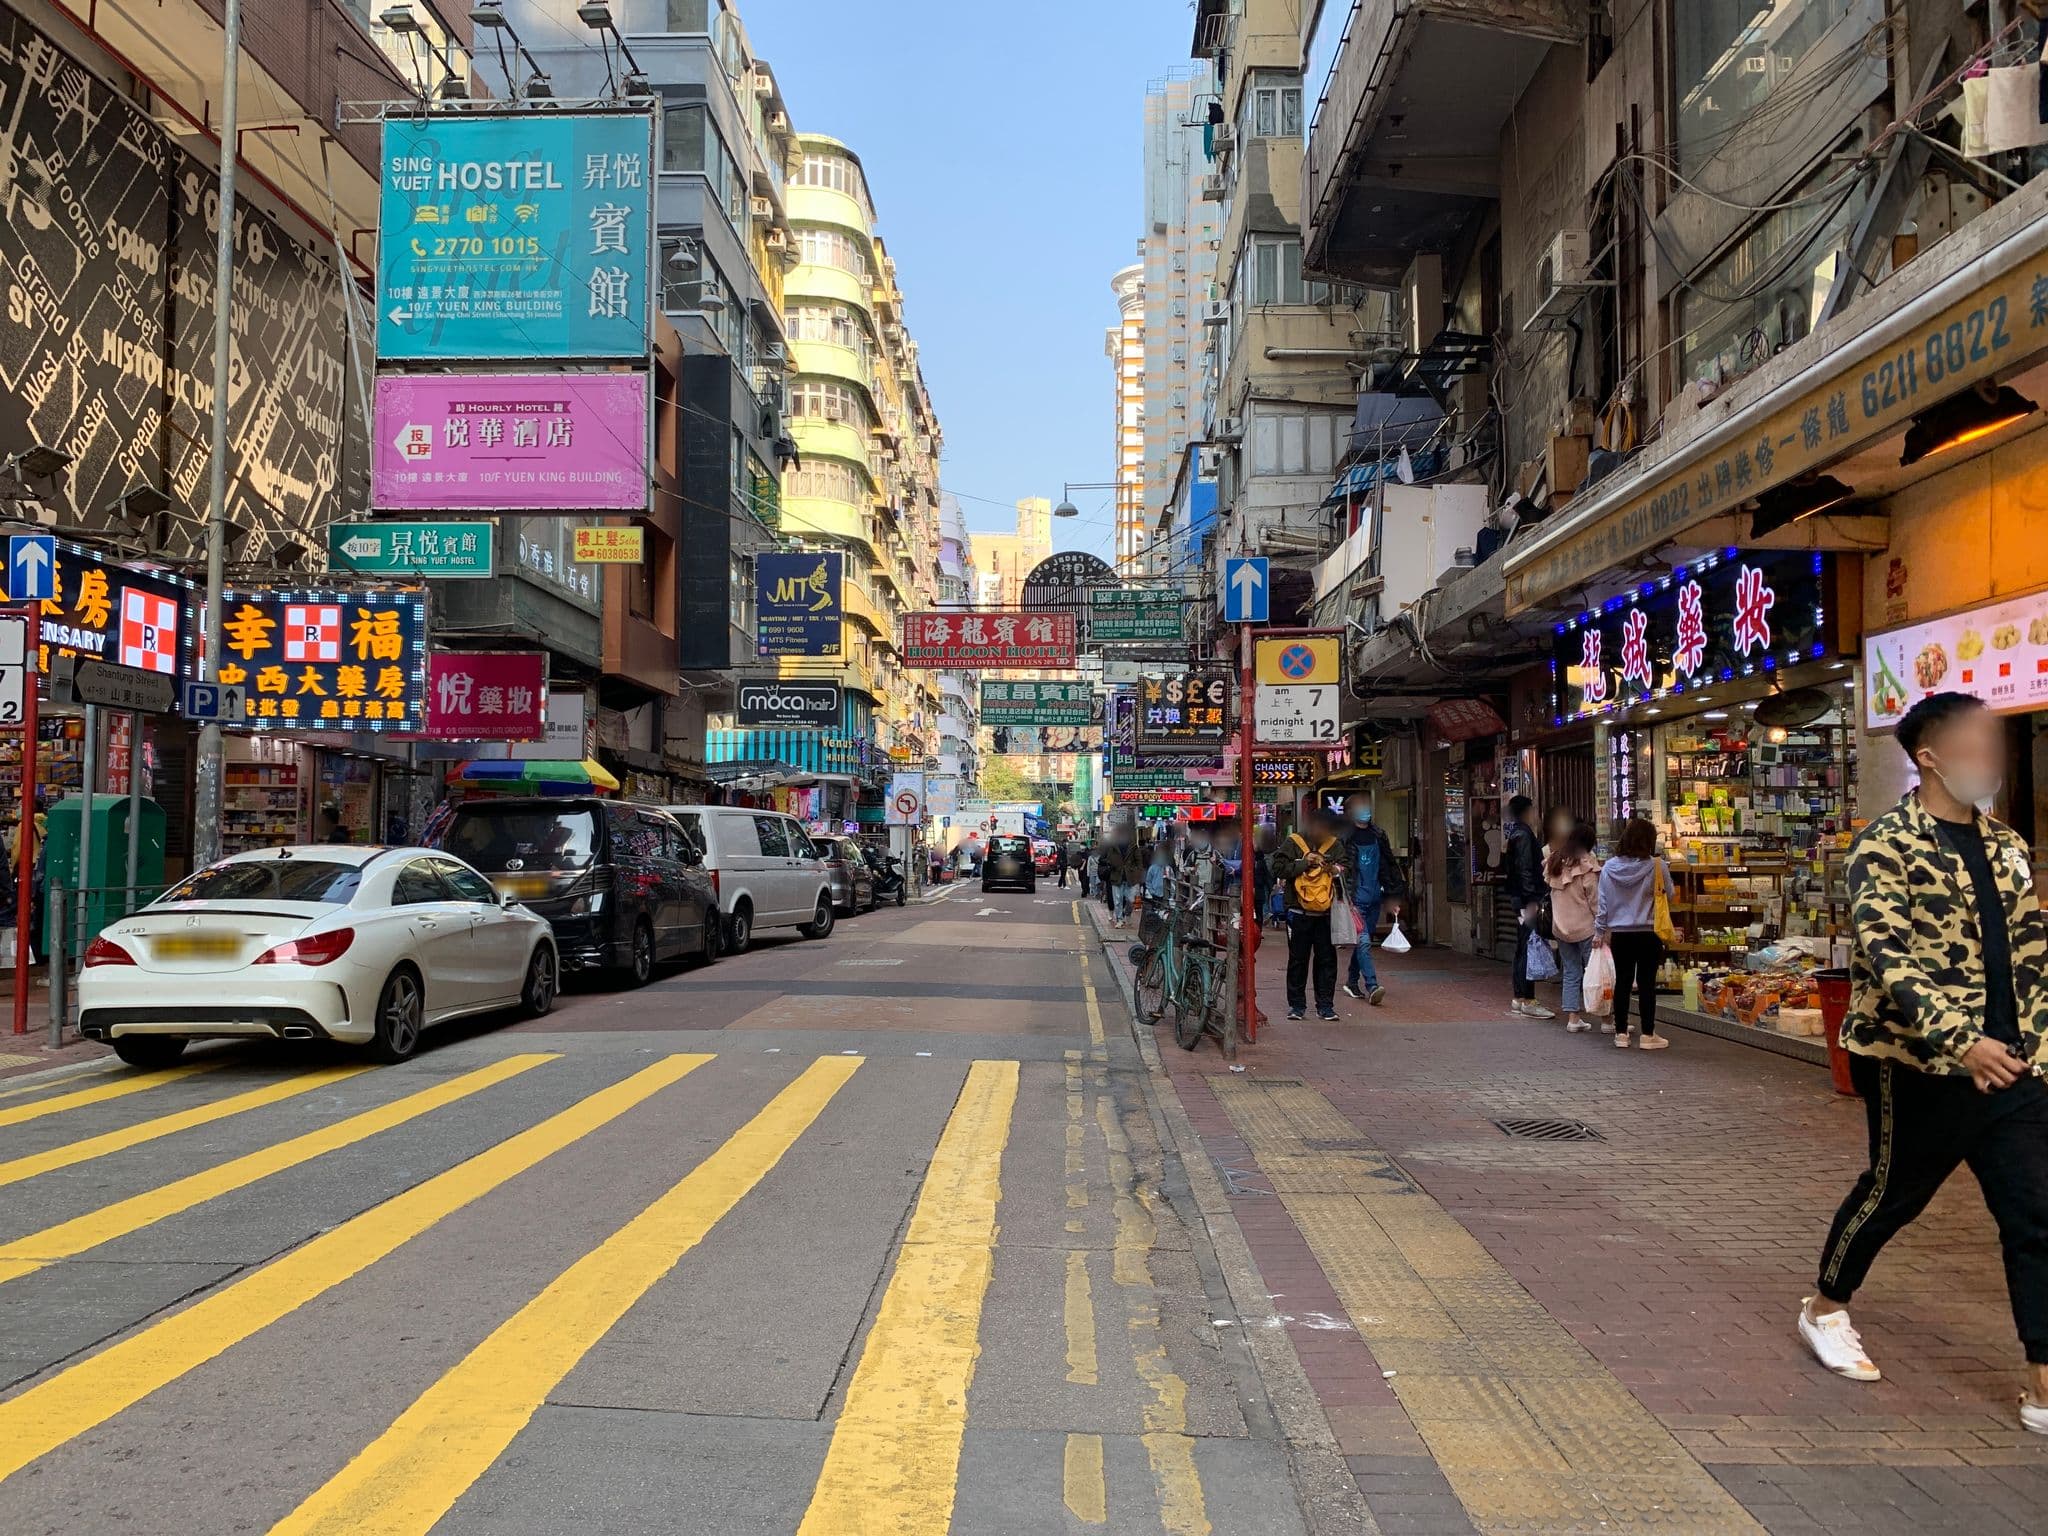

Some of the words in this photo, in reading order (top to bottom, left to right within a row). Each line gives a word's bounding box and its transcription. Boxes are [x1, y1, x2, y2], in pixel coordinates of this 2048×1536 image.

[392, 157, 432, 172] SING
[392, 175, 432, 192] YUET
[438, 162, 563, 190] HOSTEL
[46, 151, 100, 260] Broome
[112, 273, 159, 344] Street
[434, 236, 484, 256] 2770
[491, 236, 540, 255] 1015
[18, 255, 69, 336] Grand
[232, 265, 278, 320] Prince
[388, 286, 413, 300] 10樓
[408, 302, 433, 312] 10/F
[437, 301, 470, 311] YUEN
[474, 301, 502, 311] KING
[506, 301, 562, 311] BUILDING
[1861, 347, 1919, 418] 6211
[1925, 295, 2012, 384] 8822
[21, 349, 62, 411] West
[231, 358, 243, 388] 2
[468, 404, 512, 413] HOURLY
[515, 404, 551, 413] HOTEL
[295, 394, 336, 445] Spring
[118, 406, 162, 478] Greene
[394, 472, 418, 483] 10樓
[479, 472, 501, 483] 10/F
[503, 472, 537, 483] YUEN
[539, 472, 566, 483] KING
[568, 472, 623, 483] BUILDING
[577, 530, 618, 547] 樓上髮
[411, 557, 428, 565] SING
[431, 557, 447, 565] YUET
[450, 557, 476, 565] HOSTEL
[596, 548, 640, 560] 60380538
[766, 558, 834, 612] MTS
[223, 604, 278, 660] 幸
[350, 607, 403, 661] 福
[924, 616, 1055, 646] 海龍賓館
[821, 644, 840, 654] 2/F
[907, 646, 945, 658] HOI
[948, 646, 1001, 658] LOON
[1006, 645, 1072, 658] HOTEL
[96, 666, 134, 686] Shantung
[135, 672, 160, 688] Street
[218, 663, 406, 698] 中西大藥房
[983, 683, 1094, 701] 麗晶賓館
[1146, 679, 1162, 704] ¥
[1166, 680, 1183, 704] $
[1187, 679, 1204, 703] £
[1207, 680, 1224, 704] €
[1308, 689, 1323, 707] 7
[194, 689, 212, 714] P
[747, 695, 804, 711] moca
[806, 697, 831, 711] hair
[1271, 698, 1294, 708] 上午
[1260, 717, 1304, 727] midnight
[1309, 719, 1335, 738] 12
[1271, 728, 1294, 738] 午夜
[821, 735, 854, 749] Venus
[1254, 763, 1295, 771] CHANGE
